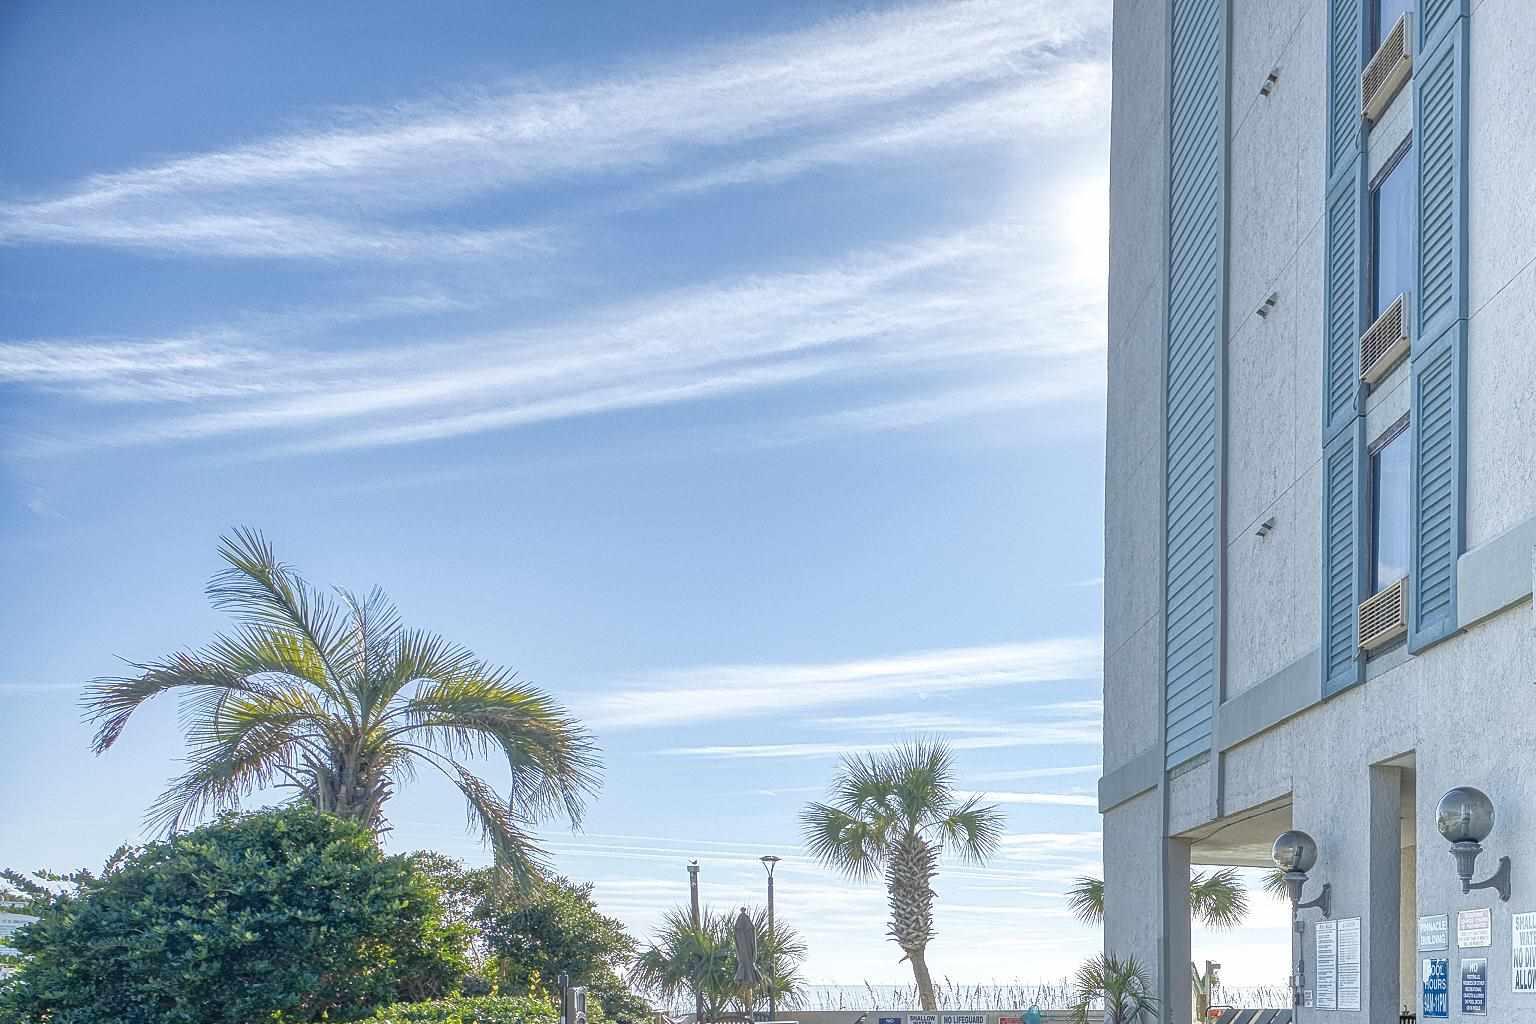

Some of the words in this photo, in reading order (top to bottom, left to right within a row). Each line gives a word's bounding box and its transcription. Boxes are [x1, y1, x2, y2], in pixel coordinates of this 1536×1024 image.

[1513, 946, 1524, 968] NO
[1424, 979, 1447, 991] HOURS
[944, 1016, 952, 1024] NO
[953, 1016, 984, 1024] LIFEGUARD
